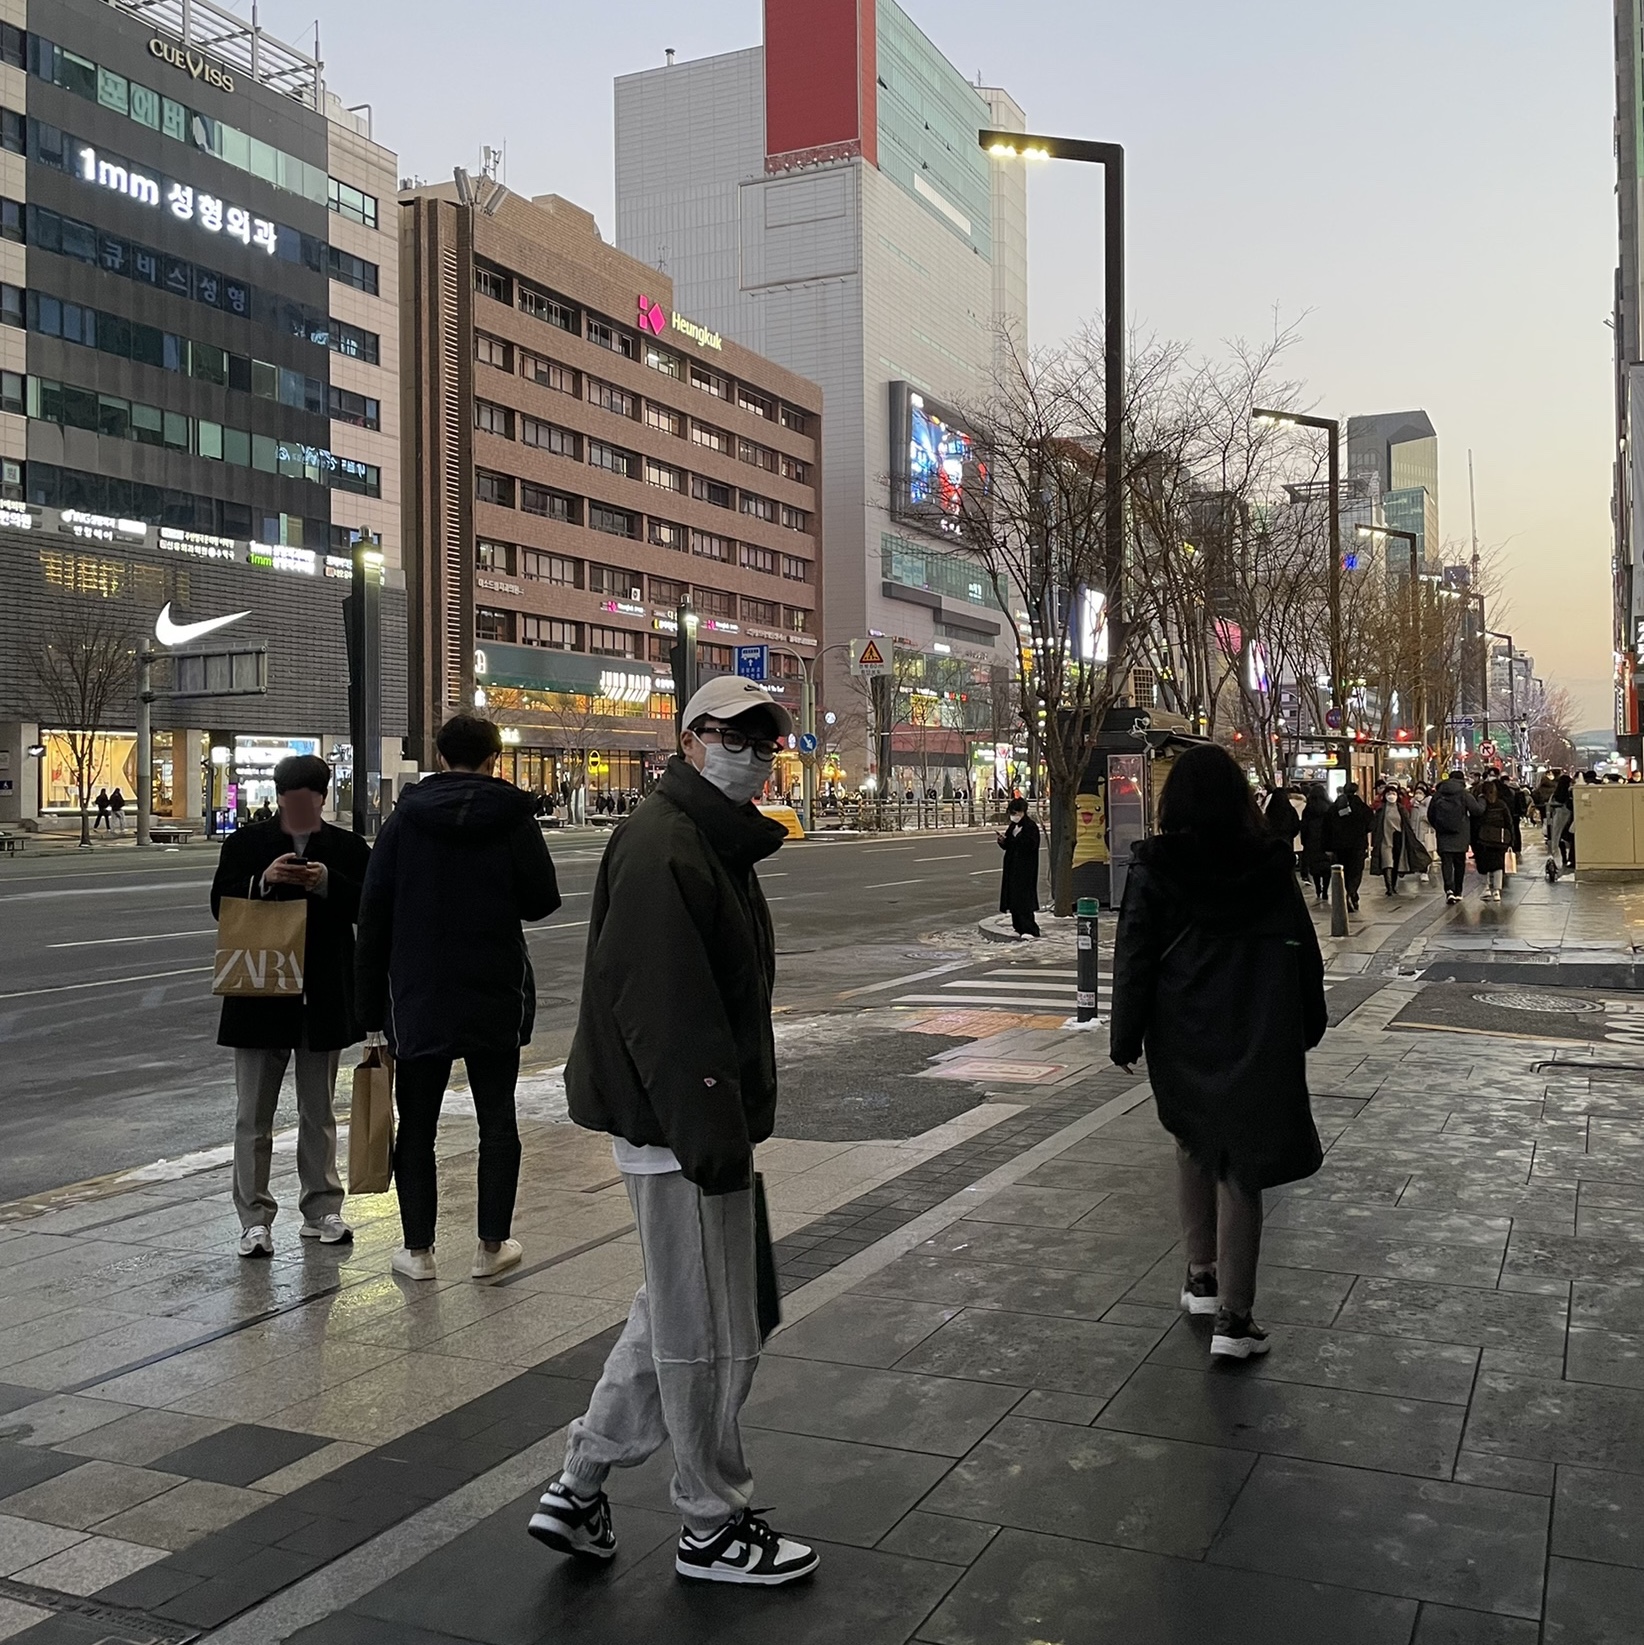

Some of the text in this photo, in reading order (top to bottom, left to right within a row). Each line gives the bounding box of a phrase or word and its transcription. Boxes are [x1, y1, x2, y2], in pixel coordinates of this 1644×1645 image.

[149, 38, 235, 93] CUEVISS
[99, 69, 184, 141] 포에버
[80, 147, 278, 255] 1mm 성형외과
[671, 311, 722, 351] Heungkuk
[250, 553, 272, 566] 1mm
[628, 674, 652, 690] HAIR
[212, 949, 304, 991] ZARA
